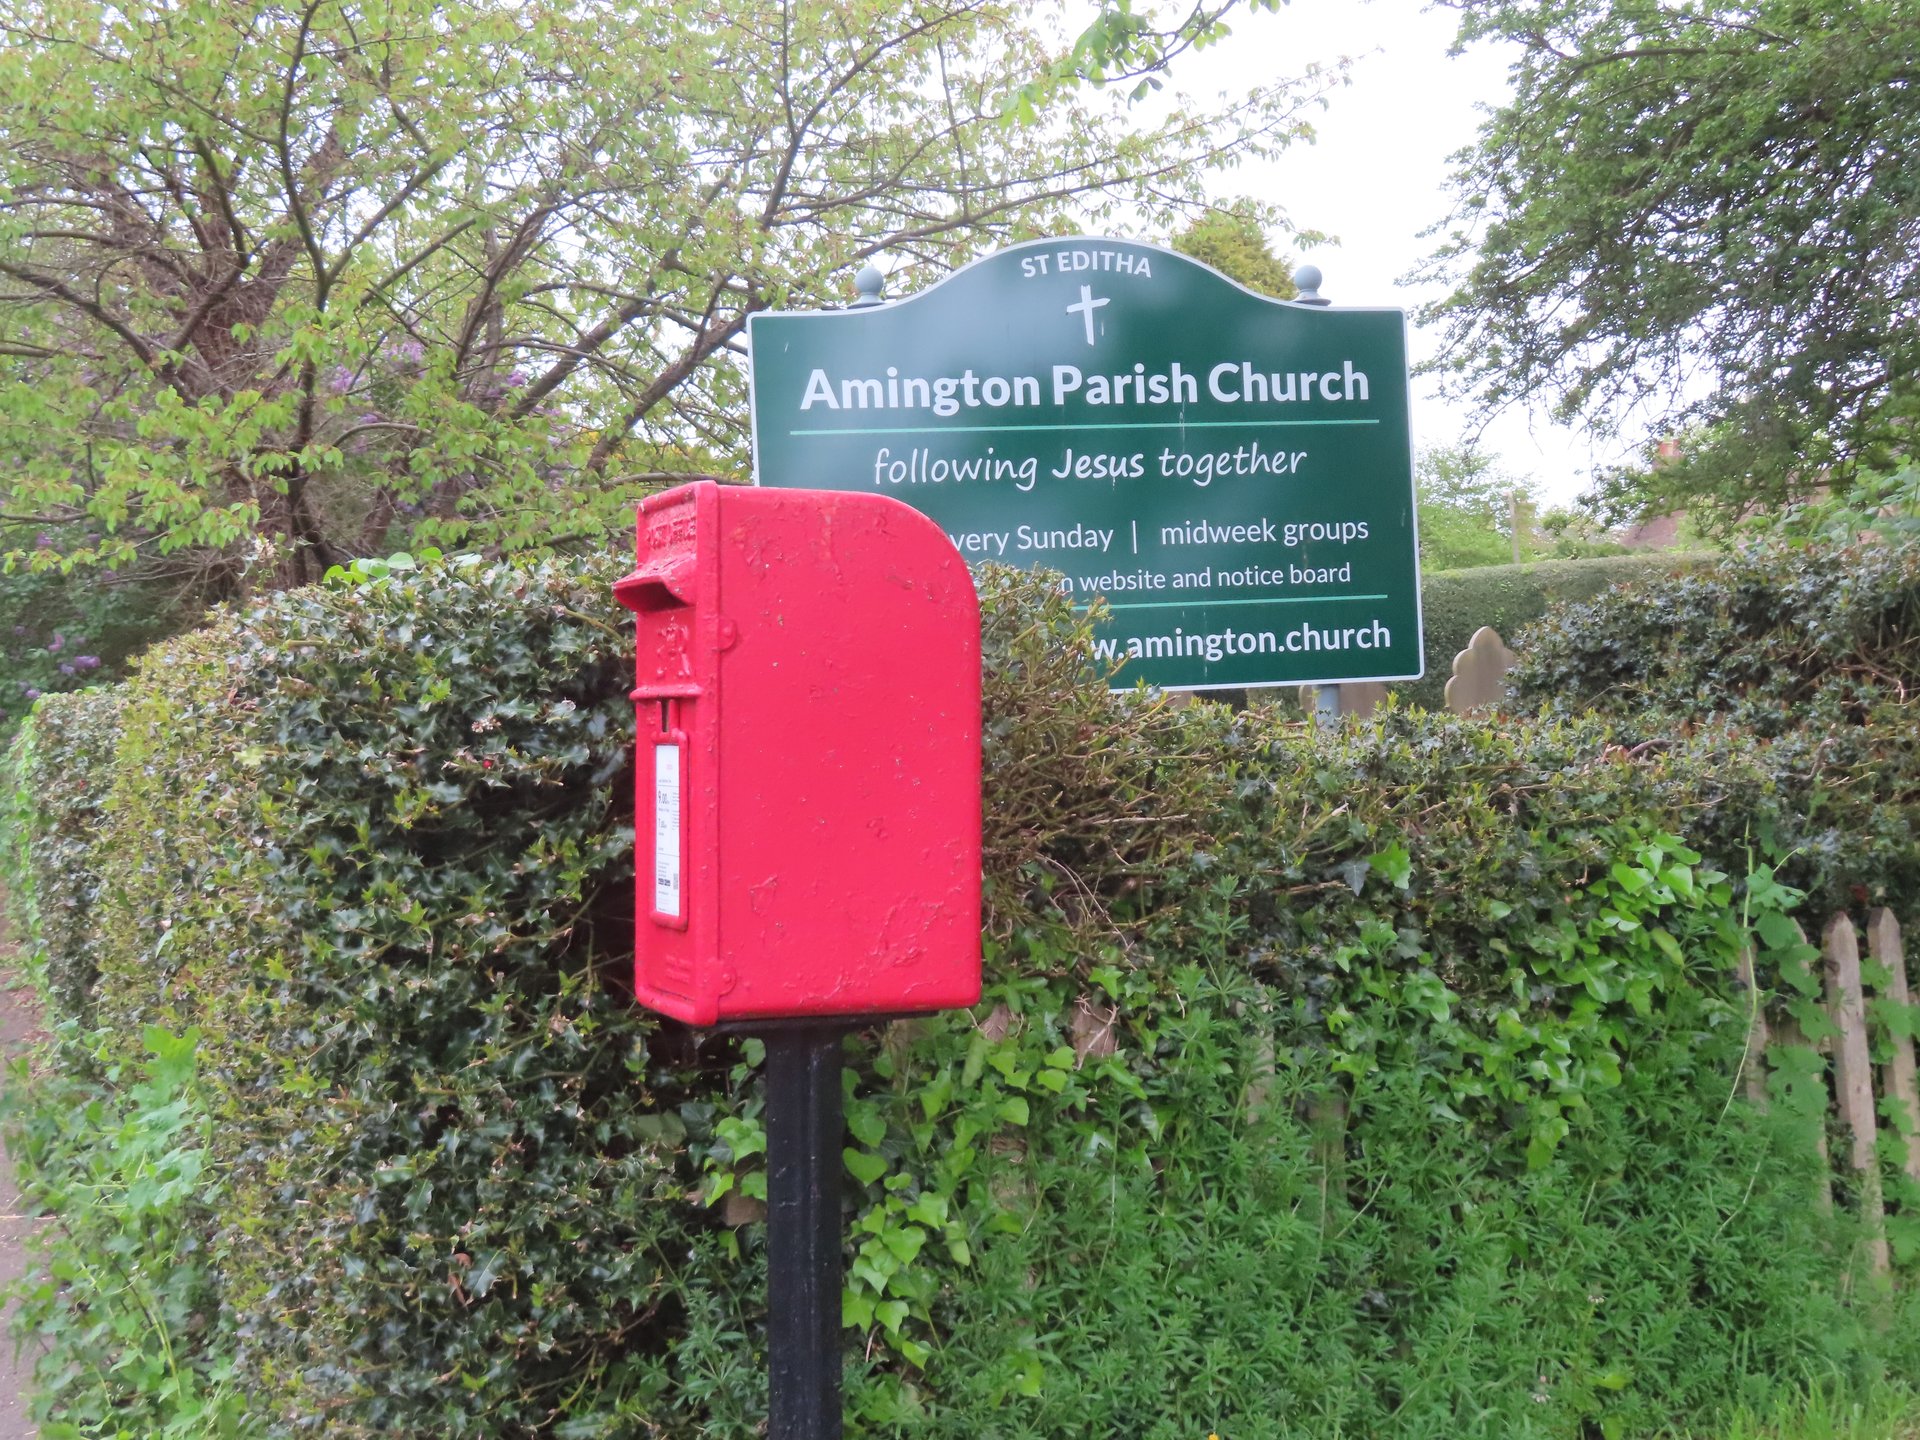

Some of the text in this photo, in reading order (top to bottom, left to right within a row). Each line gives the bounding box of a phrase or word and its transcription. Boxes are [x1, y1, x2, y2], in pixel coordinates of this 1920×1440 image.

[1021, 250, 1152, 279] ST EDITHA
[800, 360, 1370, 417] Amington Parish Church
[874, 442, 1308, 492] following Jesus together
[949, 517, 1369, 556] very Sunday midweek groups
[1080, 569, 1166, 592] website
[1173, 566, 1212, 588] and
[1218, 566, 1284, 587] notice
[1289, 561, 1351, 585] board
